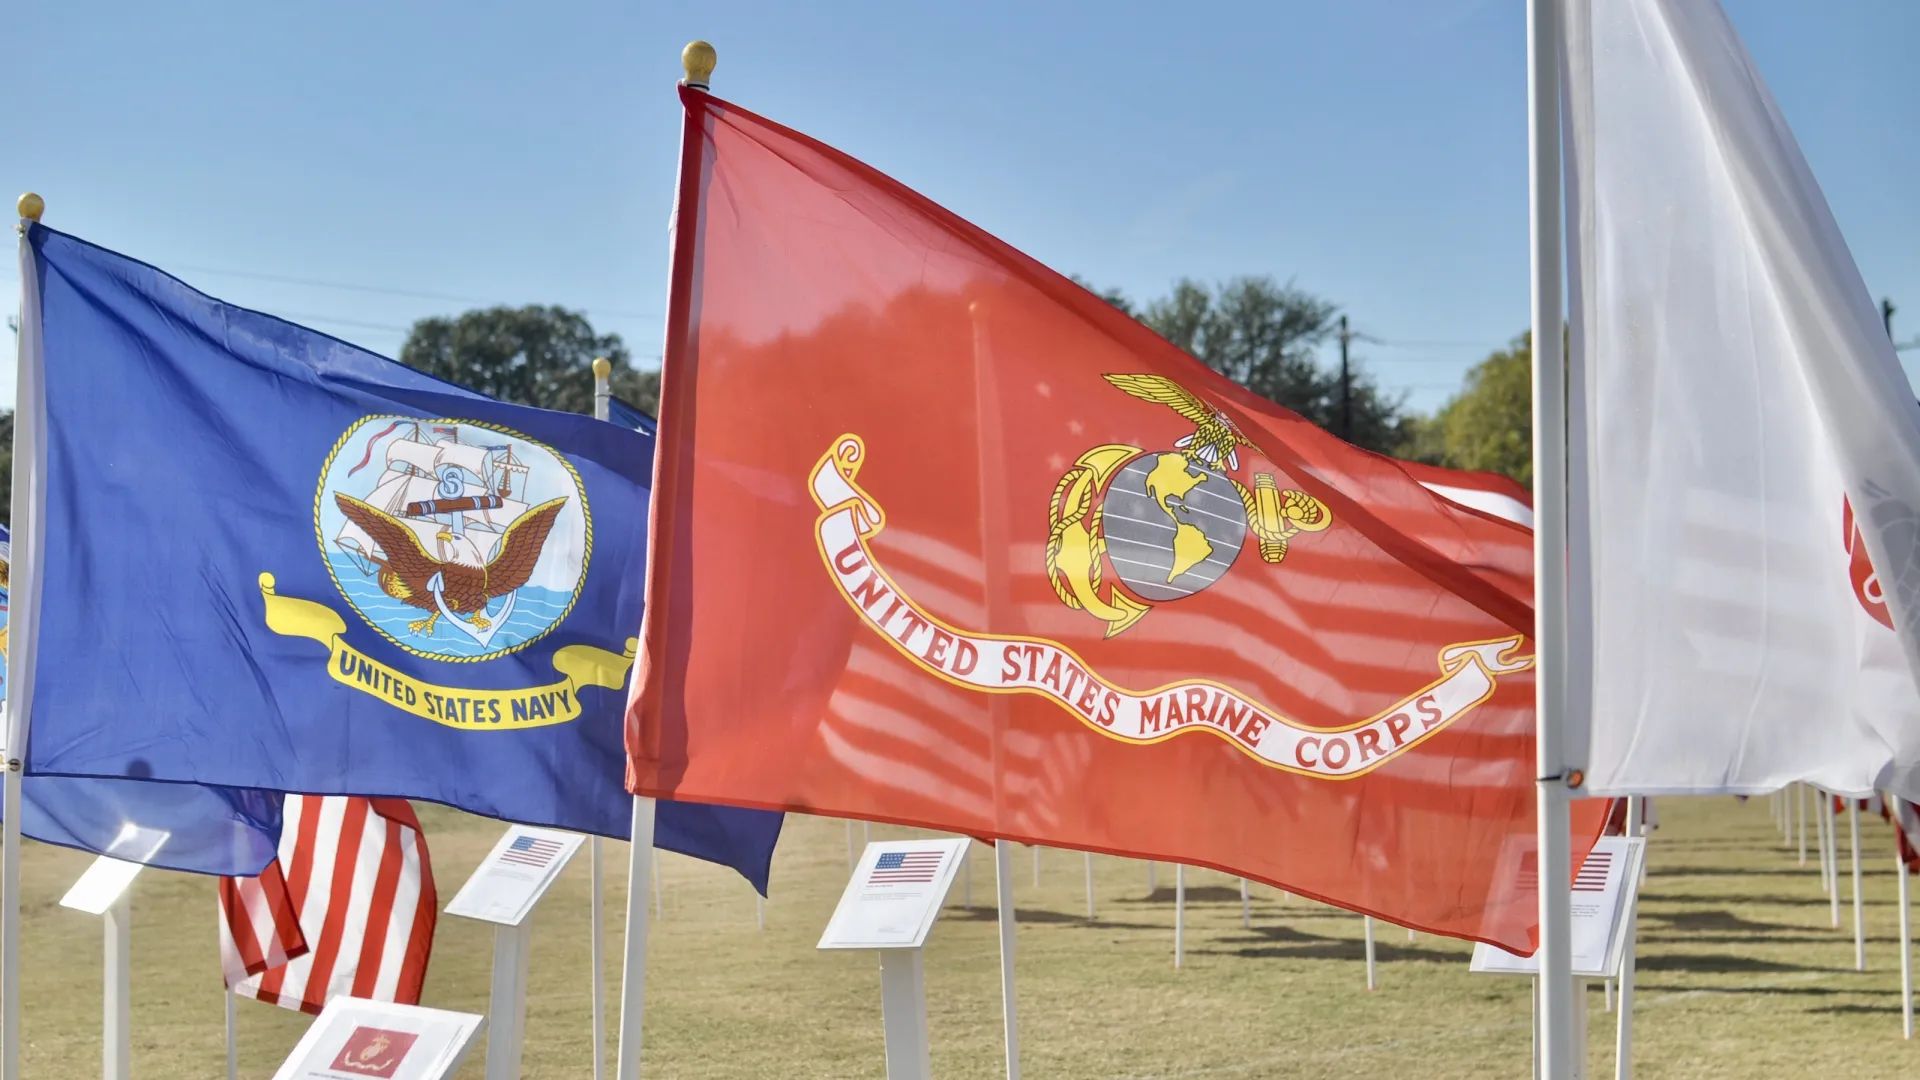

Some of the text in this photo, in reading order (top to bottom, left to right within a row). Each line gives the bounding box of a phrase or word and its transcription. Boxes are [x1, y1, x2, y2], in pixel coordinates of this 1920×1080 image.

[339, 649, 573, 723] UNITED STATES NAVY
[834, 539, 1442, 770] UNITED STATES MARINE CORPS
